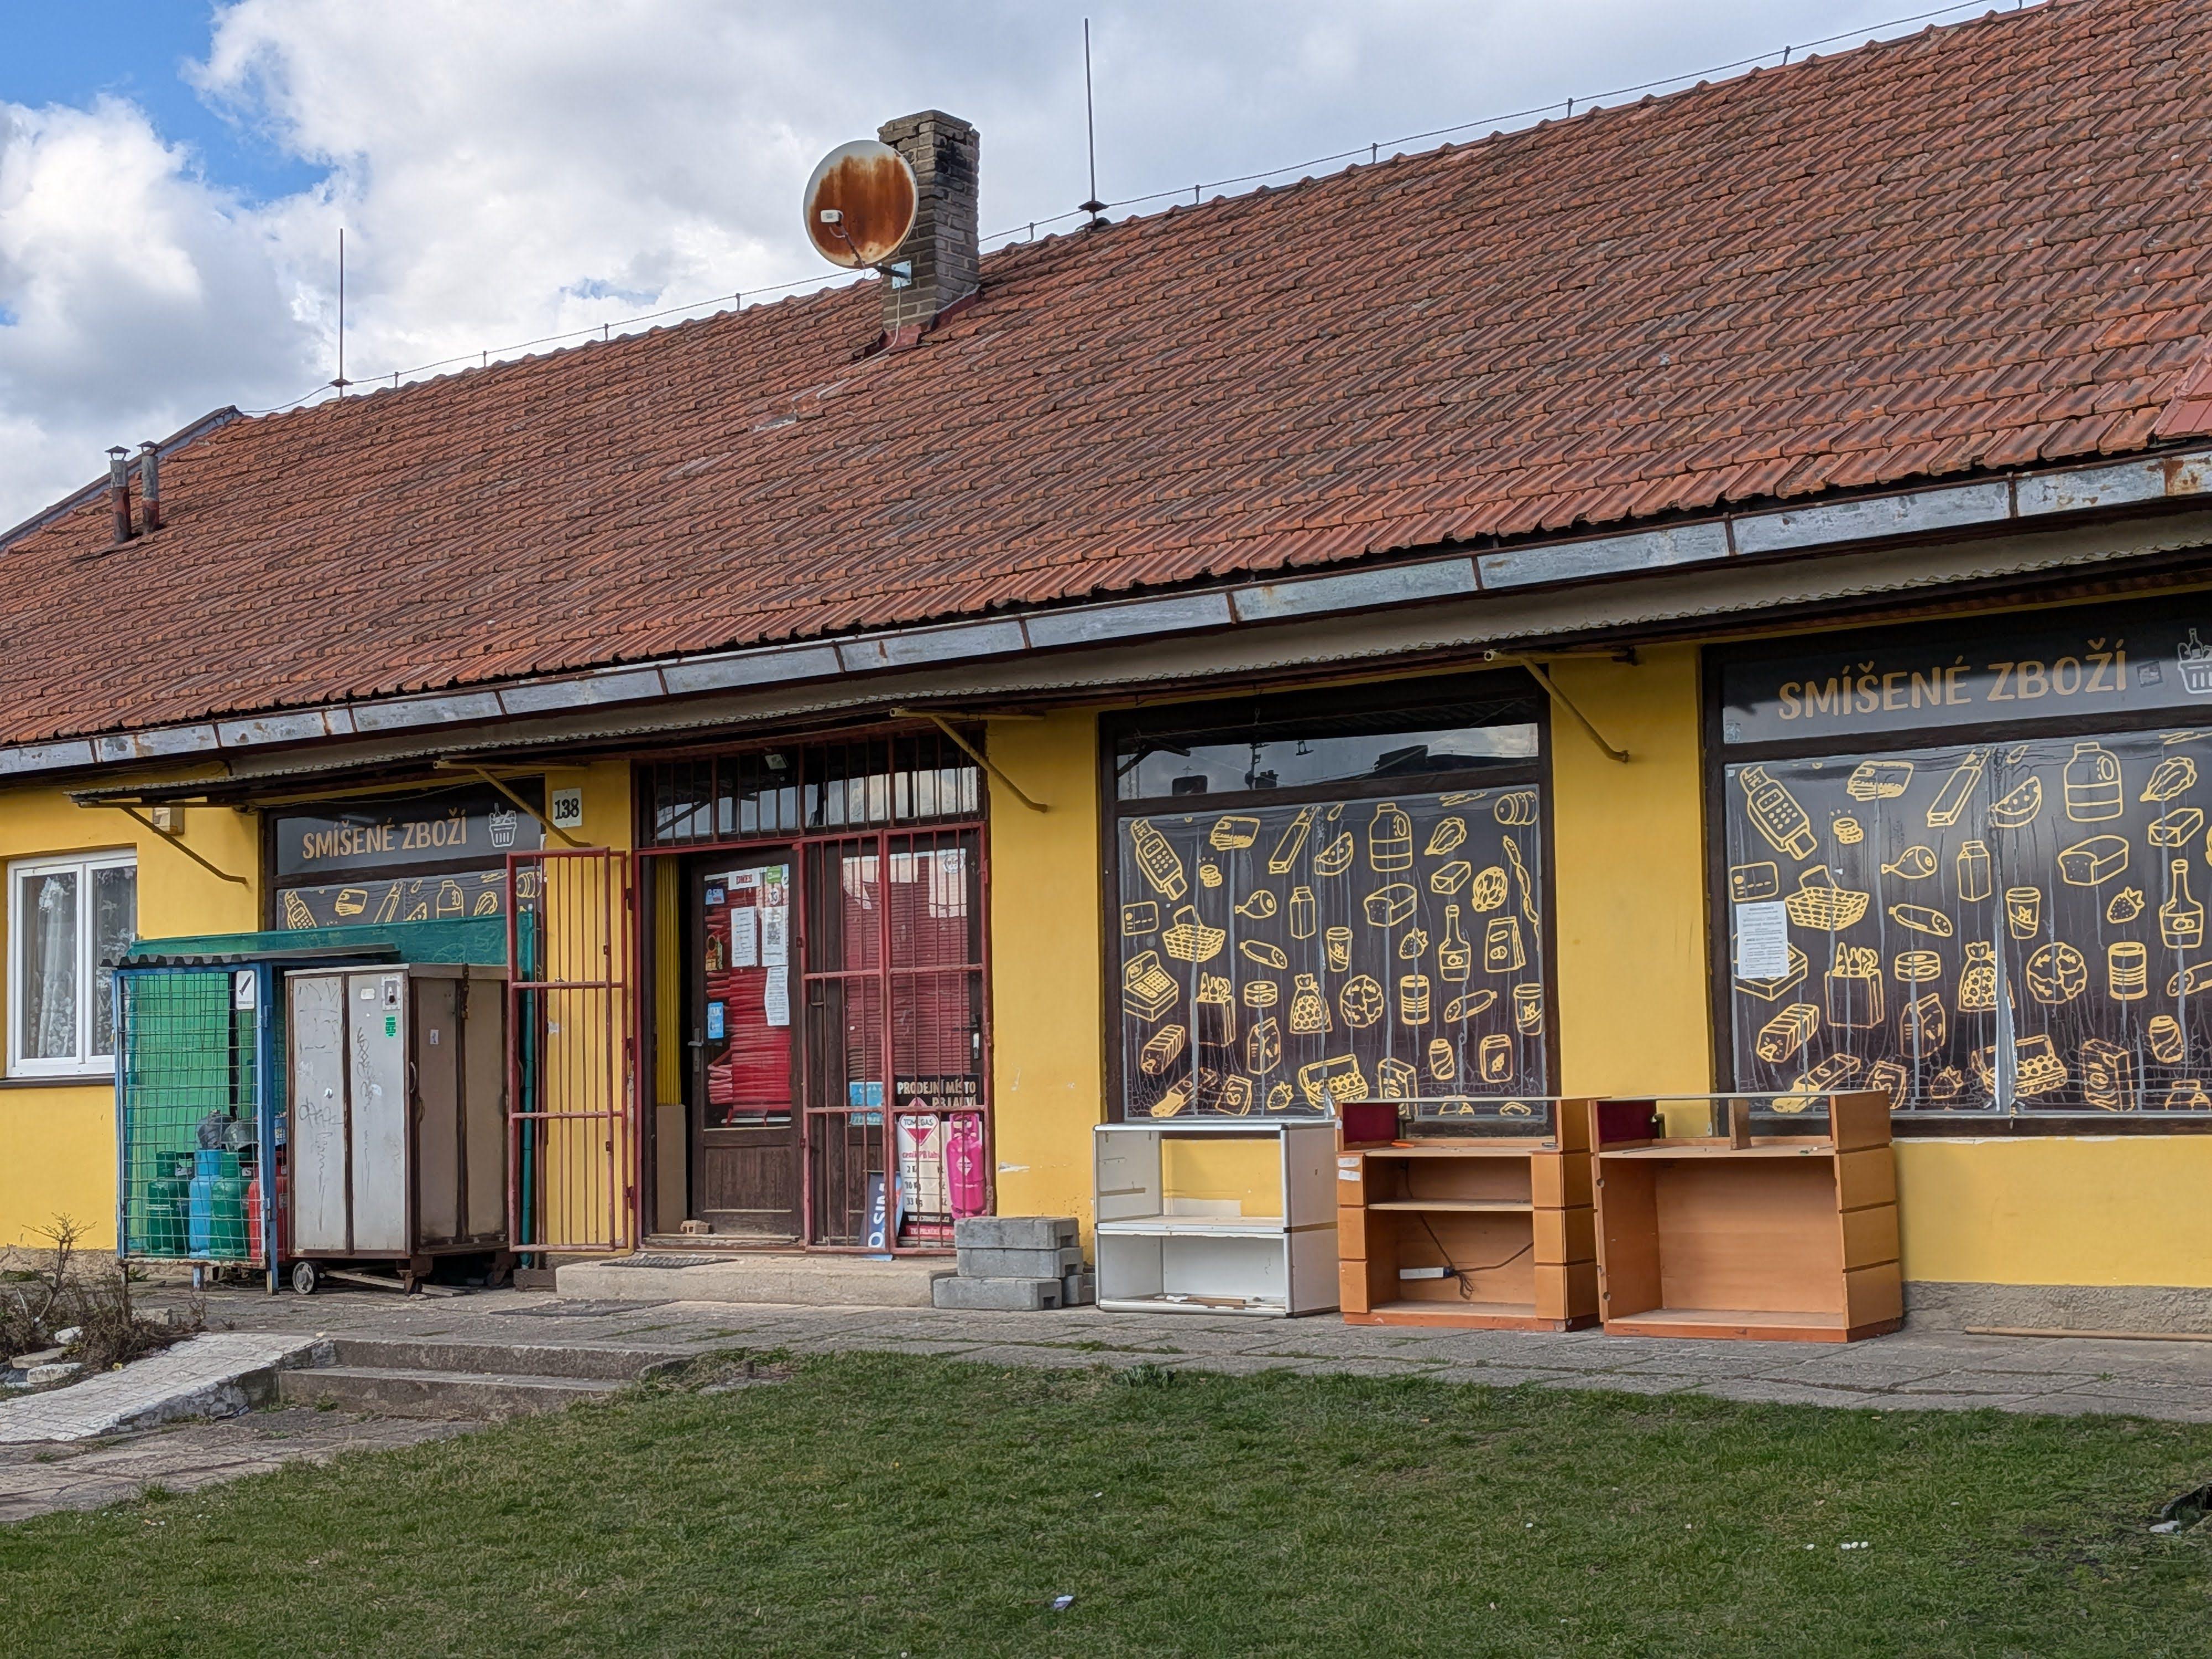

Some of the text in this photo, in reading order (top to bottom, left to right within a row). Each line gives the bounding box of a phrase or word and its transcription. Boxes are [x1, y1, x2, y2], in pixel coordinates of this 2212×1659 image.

[1778, 637, 2127, 721] SMÍŠENÉ ZBOŽÍ
[554, 797, 580, 820] 138
[302, 808, 467, 859] SMÍŠENÉ ZBOŽÍ
[904, 1118, 933, 1126] TOMGAS
